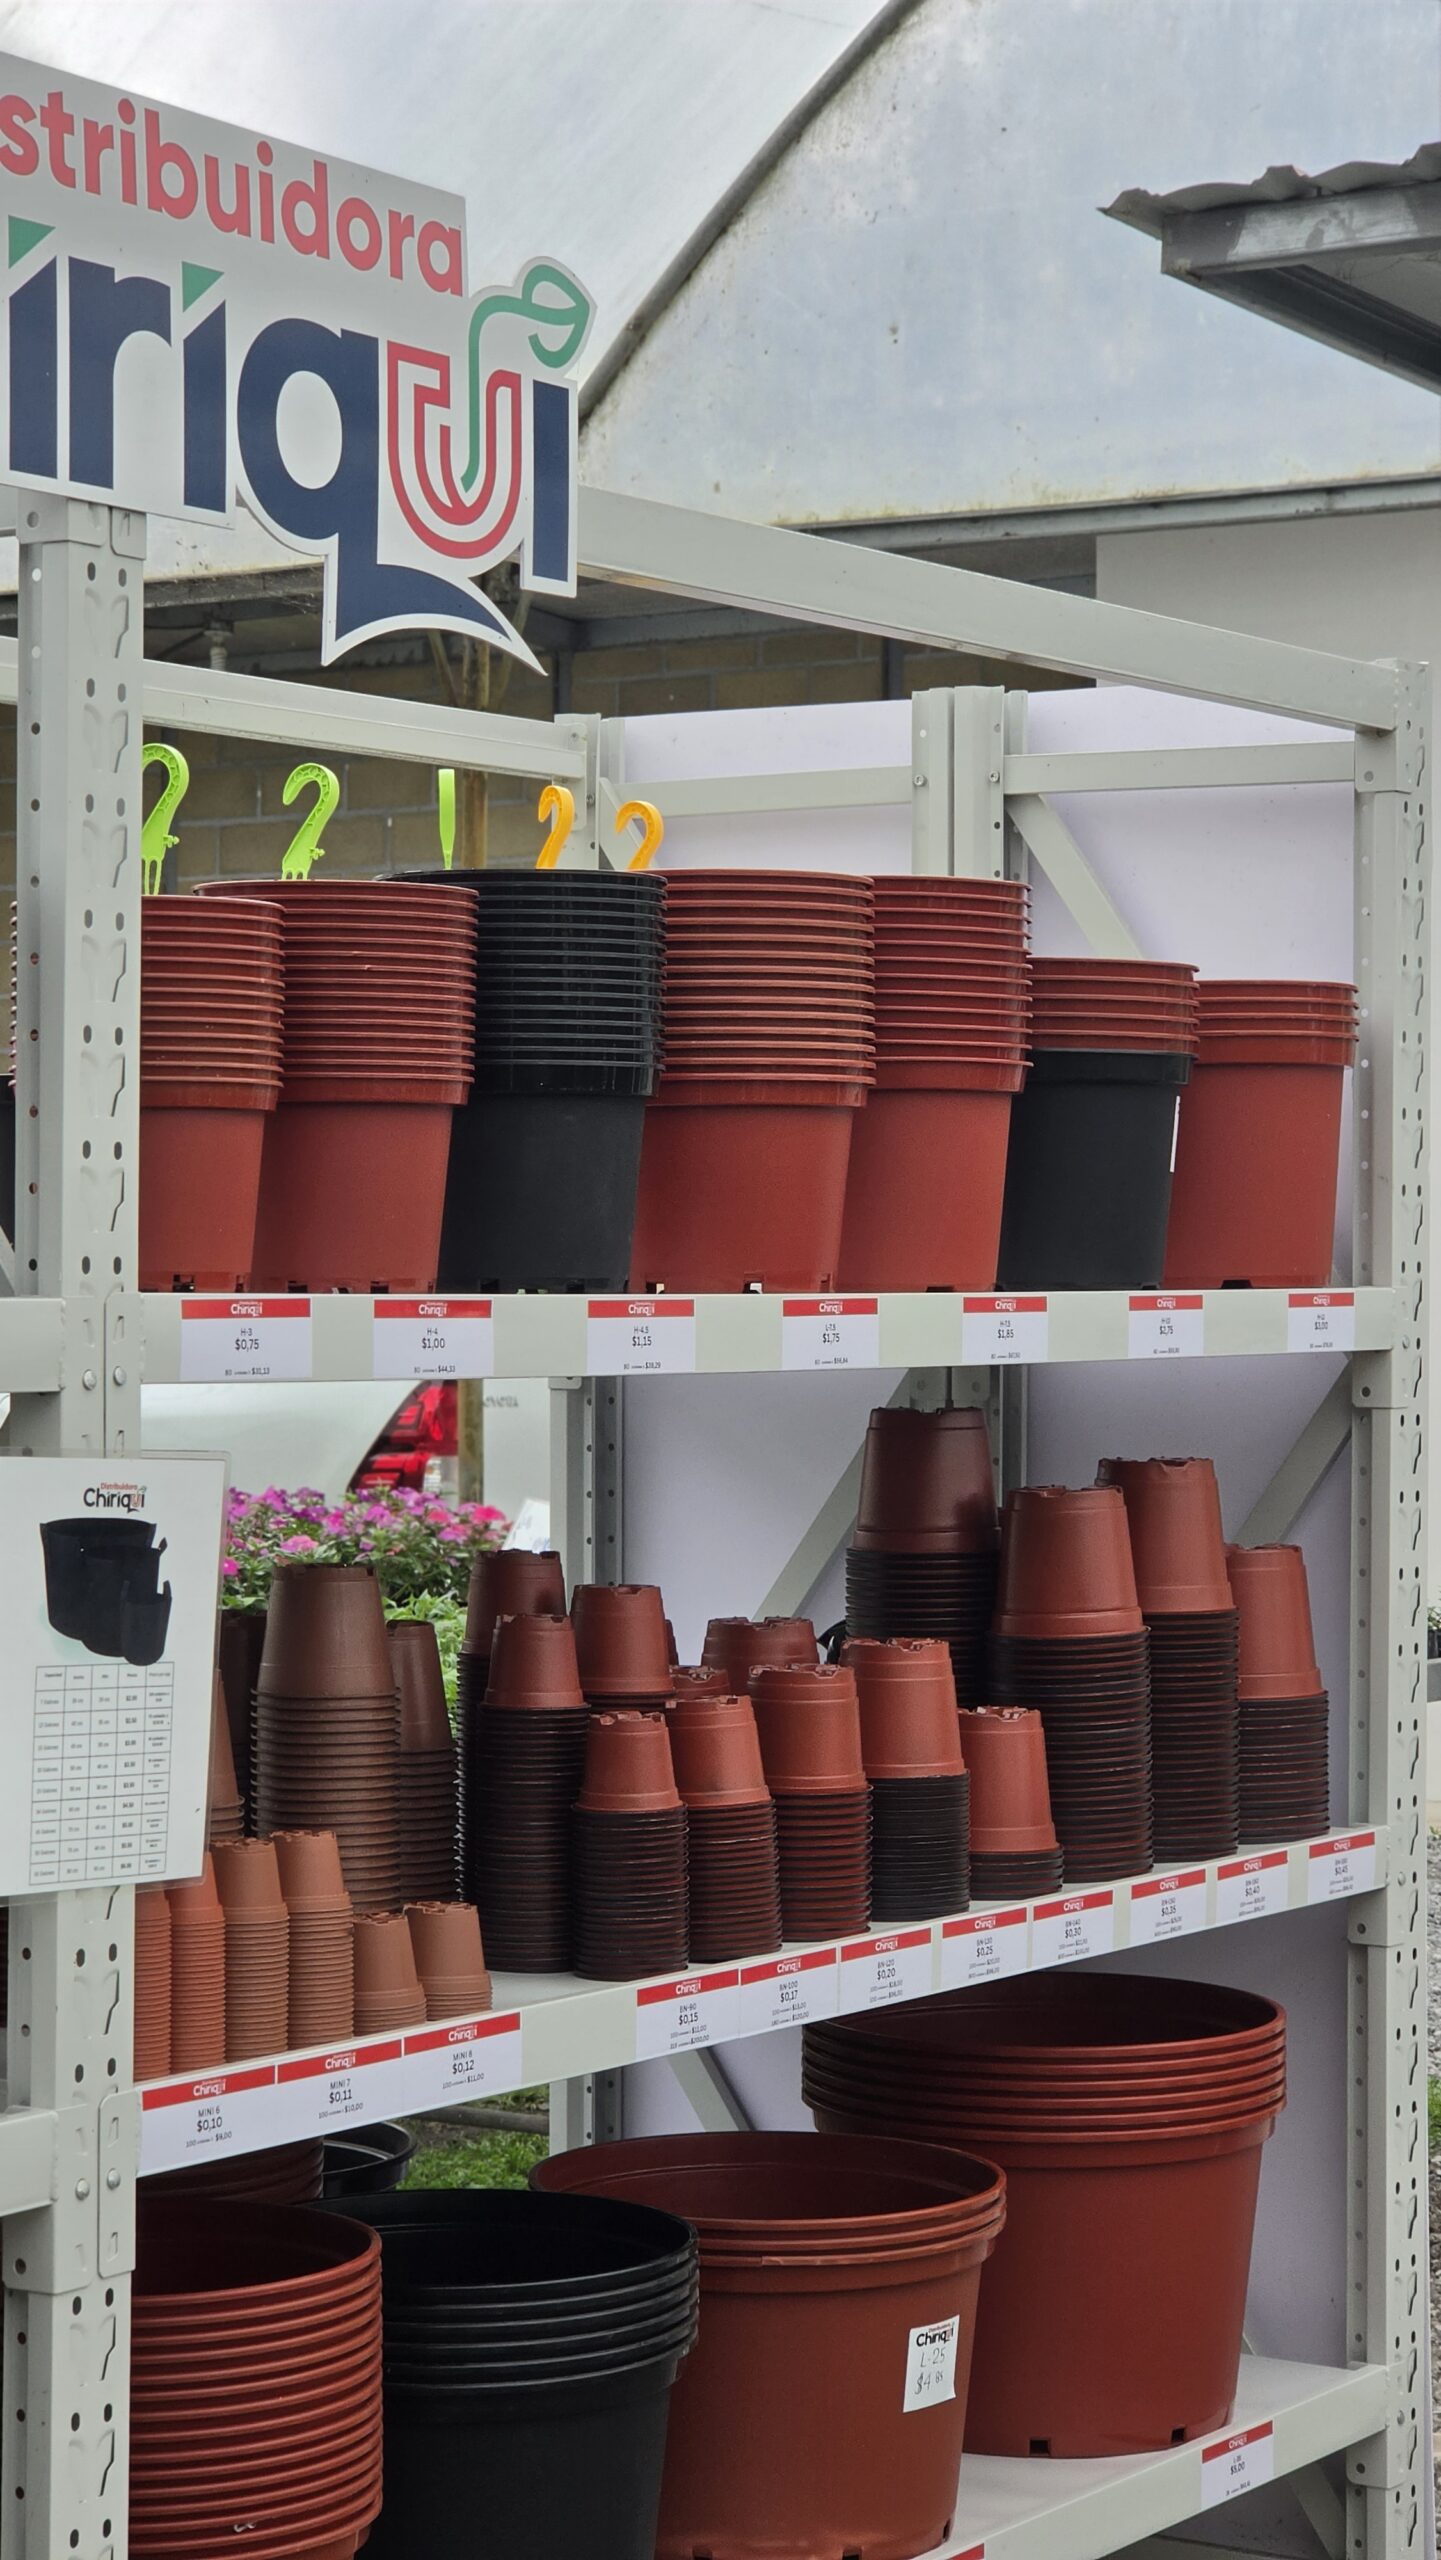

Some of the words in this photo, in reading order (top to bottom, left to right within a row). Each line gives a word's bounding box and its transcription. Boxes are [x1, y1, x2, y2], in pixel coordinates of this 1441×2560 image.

[0, 90, 463, 297] stribuidora
[235, 1338, 259, 1352] $0,75
[422, 1338, 445, 1351] $1,00
[632, 1336, 652, 1348] $1,15
[822, 1333, 840, 1345] $1,75
[976, 1945, 993, 1958] $0,25
[877, 1968, 896, 1980] $0,20
[780, 1990, 798, 2003] $0,17
[678, 2012, 698, 2025] $0,15
[453, 2052, 467, 2061] MINI
[452, 2060, 474, 2075] $0,12
[330, 2080, 346, 2089] MINI
[346, 2078, 351, 2087] 7
[329, 2089, 352, 2104] $0,11
[198, 2107, 214, 2117] MINI
[215, 2105, 220, 2114] 6
[197, 2116, 223, 2133] $0,10
